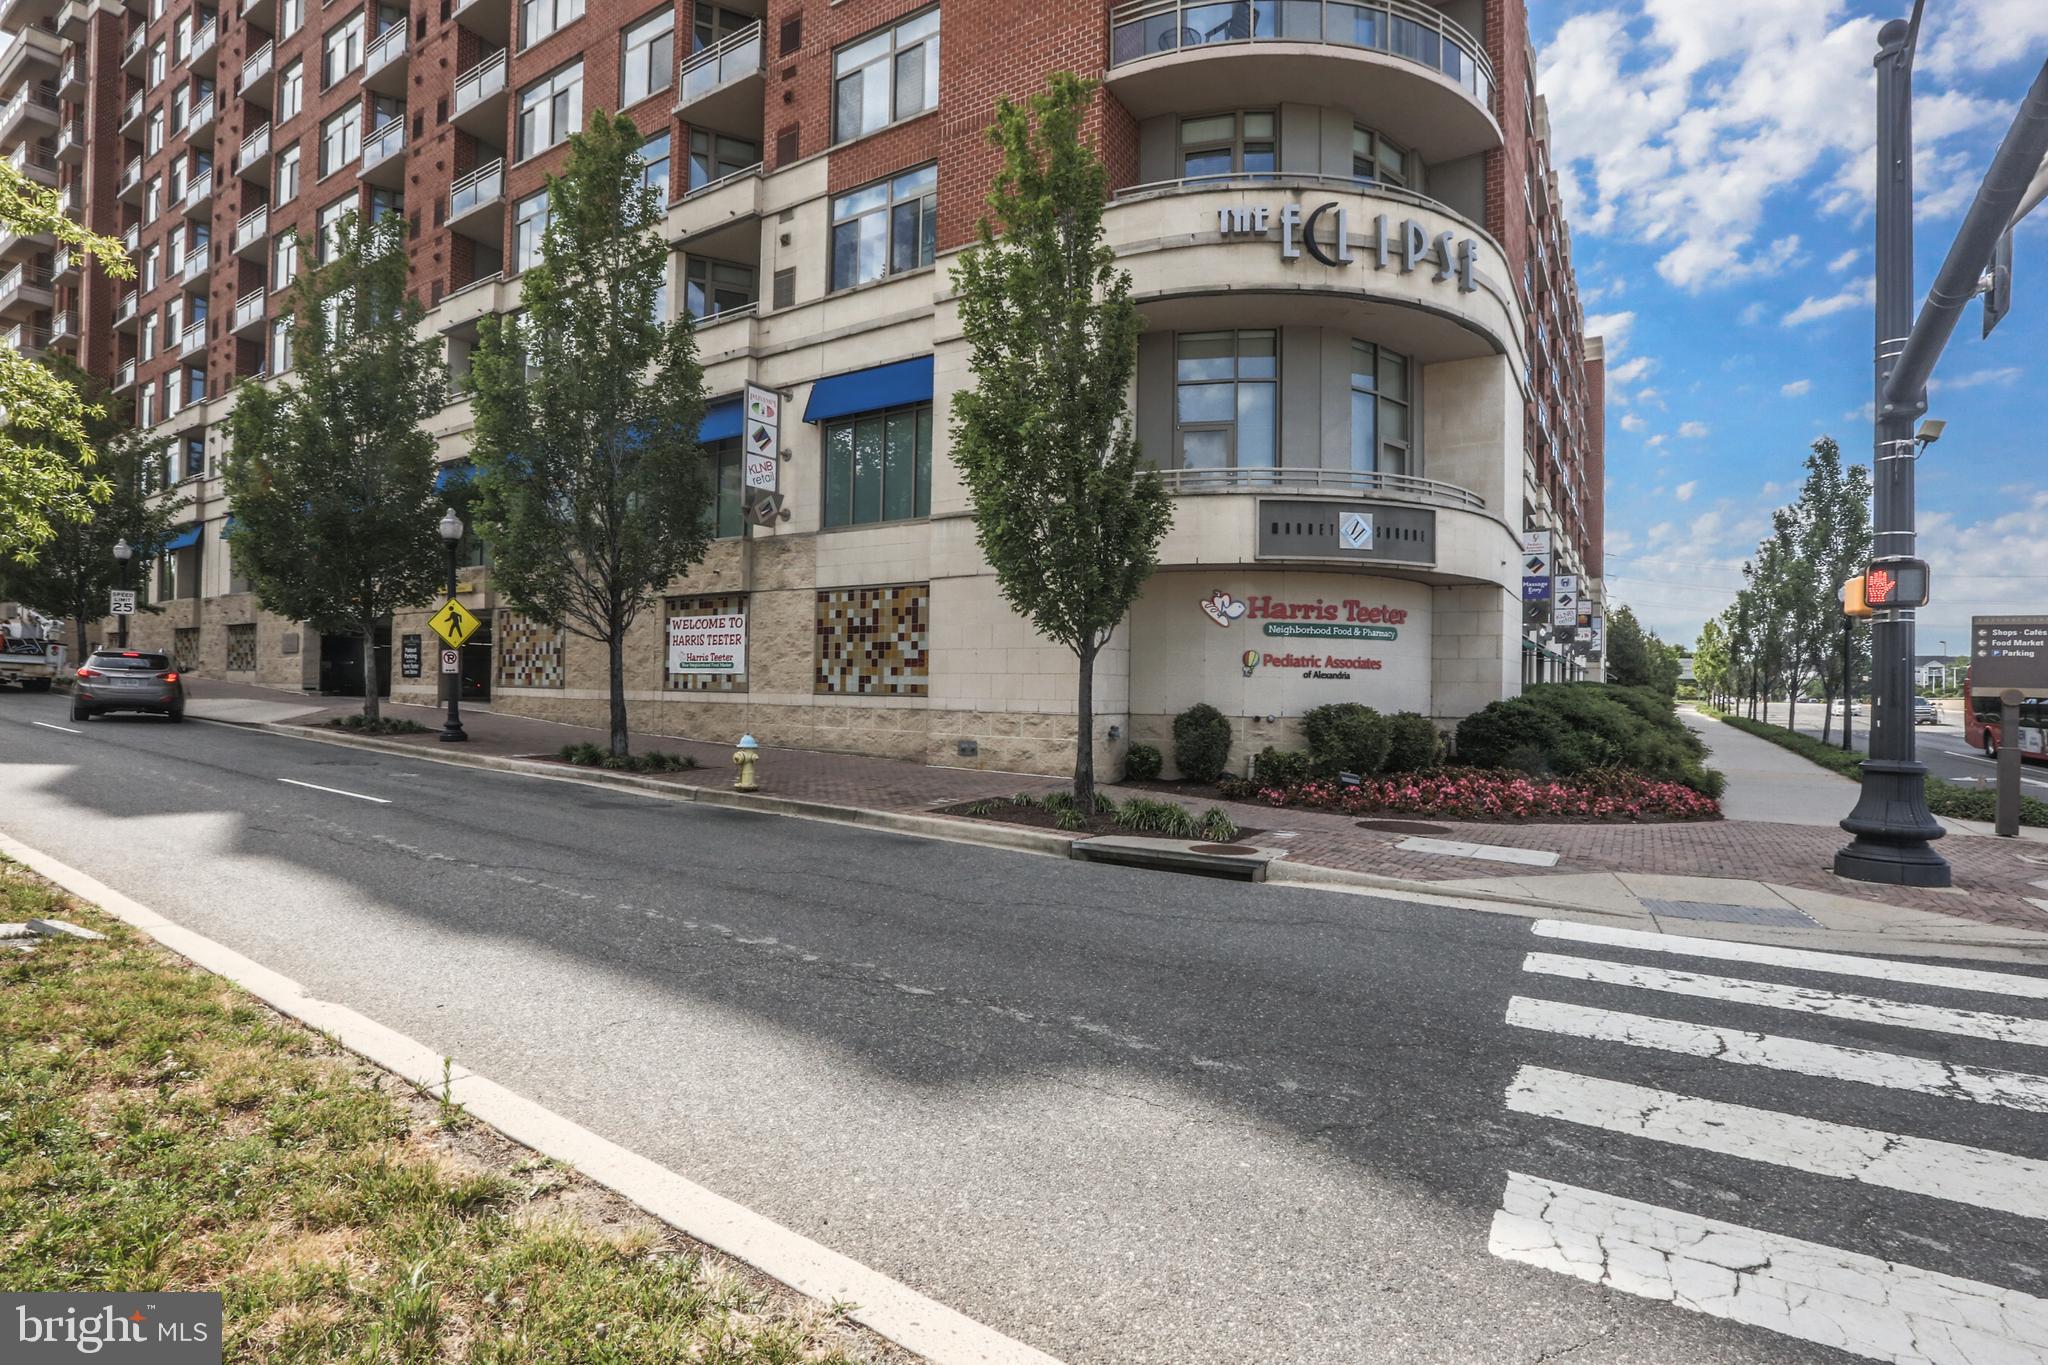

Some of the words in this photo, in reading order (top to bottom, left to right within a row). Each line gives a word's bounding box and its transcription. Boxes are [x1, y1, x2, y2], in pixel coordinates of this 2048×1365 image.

[1217, 207, 1269, 236] THE
[1280, 201, 1478, 294] ECLIPSE
[748, 461, 774, 475] KLNB
[752, 472, 775, 485] retail
[112, 602, 133, 612] 25
[1247, 596, 1338, 620] Harris
[1343, 599, 1408, 625] Teeter
[672, 618, 726, 630] WELCOME
[729, 617, 744, 629] TO
[1268, 624, 1332, 636] Neighborhood
[1333, 626, 1352, 636] Food
[1354, 627, 1361, 636] &
[1362, 628, 1396, 640] Pharmacy
[1992, 629, 2018, 637] Shops
[2023, 628, 2048, 636] Cafés
[672, 634, 705, 646] HARRIS
[706, 633, 742, 646] TEETER
[686, 652, 709, 662] Harris
[710, 652, 734, 662] Teeter
[2002, 649, 2035, 658] Parking
[1263, 653, 1322, 668] Pediatric
[1325, 655, 1383, 670] Associates
[1303, 670, 1312, 679] of
[1312, 671, 1351, 680] Alexandria
